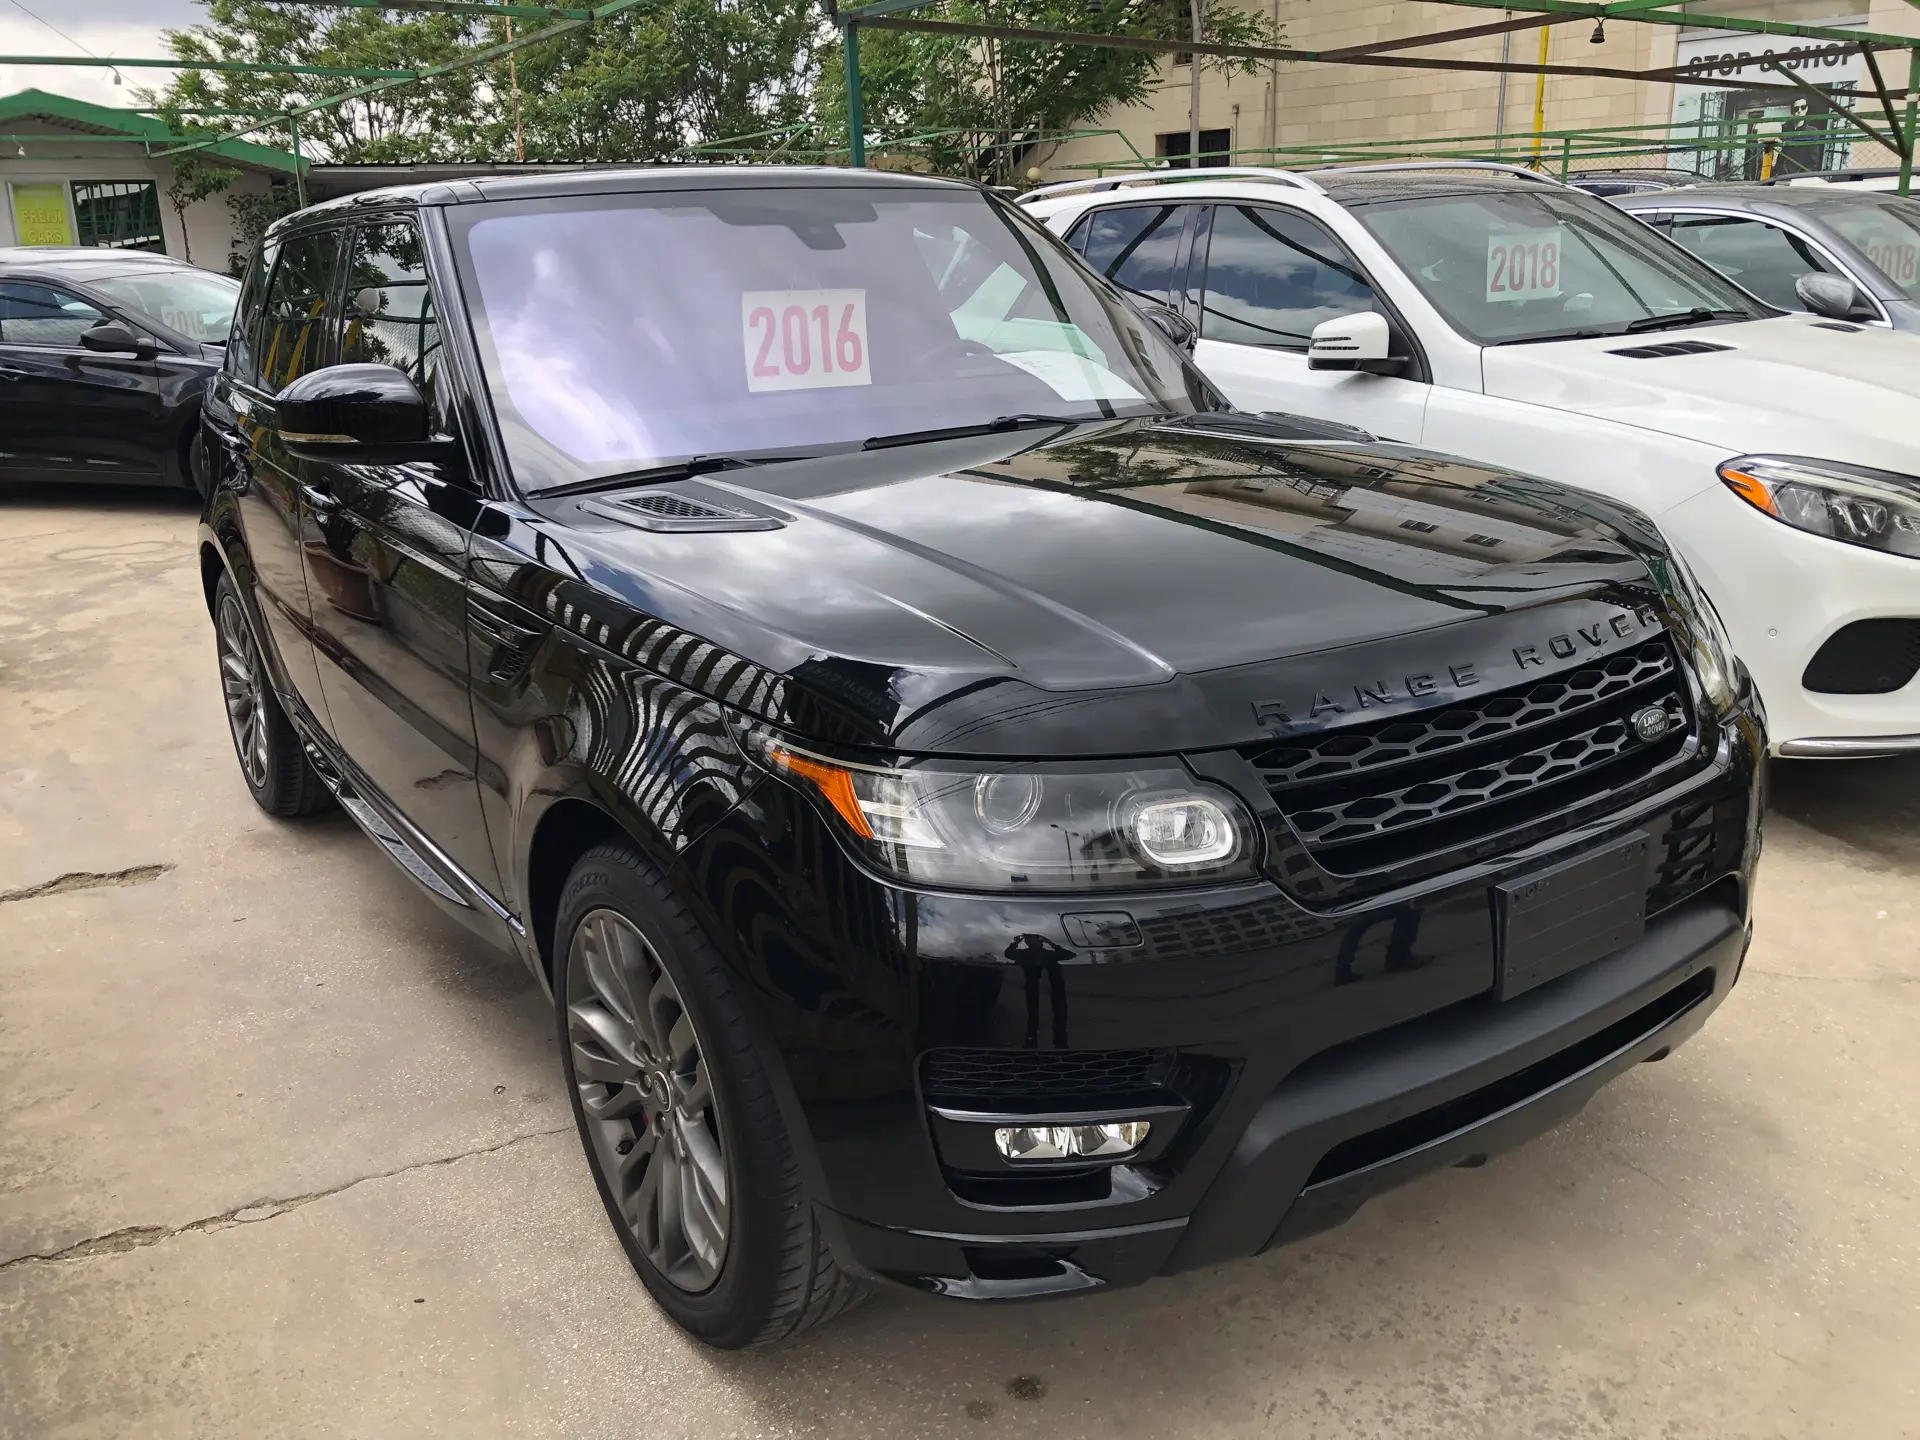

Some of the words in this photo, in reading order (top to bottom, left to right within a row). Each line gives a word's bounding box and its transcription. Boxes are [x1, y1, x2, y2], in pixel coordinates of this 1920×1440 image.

[1688, 51, 1751, 77] STOP
[1787, 41, 1860, 70] SHOP
[28, 229, 63, 243] CARS
[1490, 242, 1557, 292] 2018
[749, 303, 863, 377] 2016
[1251, 662, 1481, 727] RANGE
[1512, 603, 1661, 670] ROVER
[1643, 713, 1660, 727] LAND
[1646, 721, 1665, 736] ROVER
